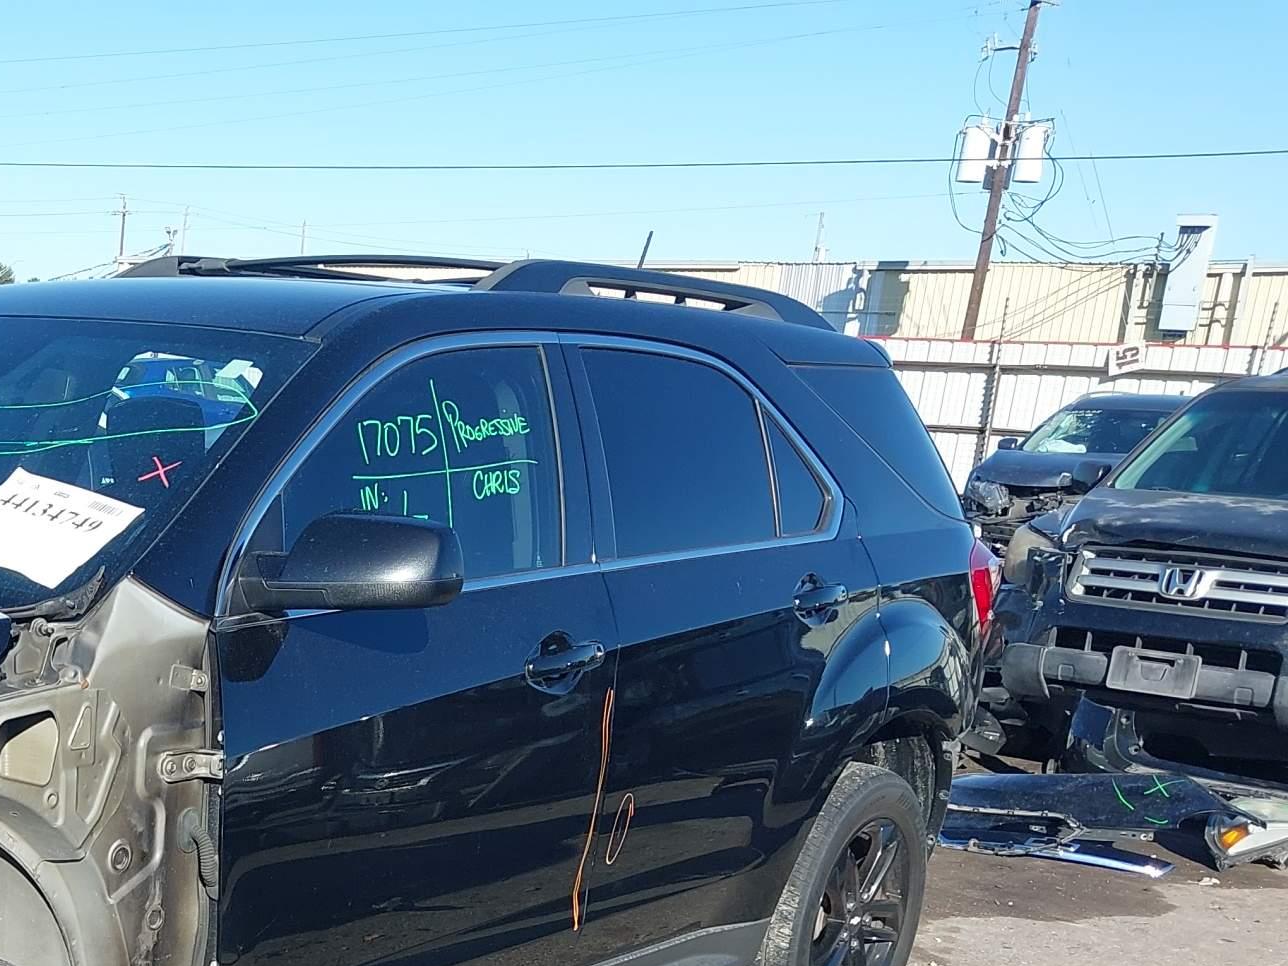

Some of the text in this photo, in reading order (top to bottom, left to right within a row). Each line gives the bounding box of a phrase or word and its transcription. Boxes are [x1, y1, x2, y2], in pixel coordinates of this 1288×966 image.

[1115, 346, 1140, 370] 15
[358, 414, 438, 465] 17075
[473, 470, 521, 500] CHRIS
[0, 494, 103, 531] 44134749
